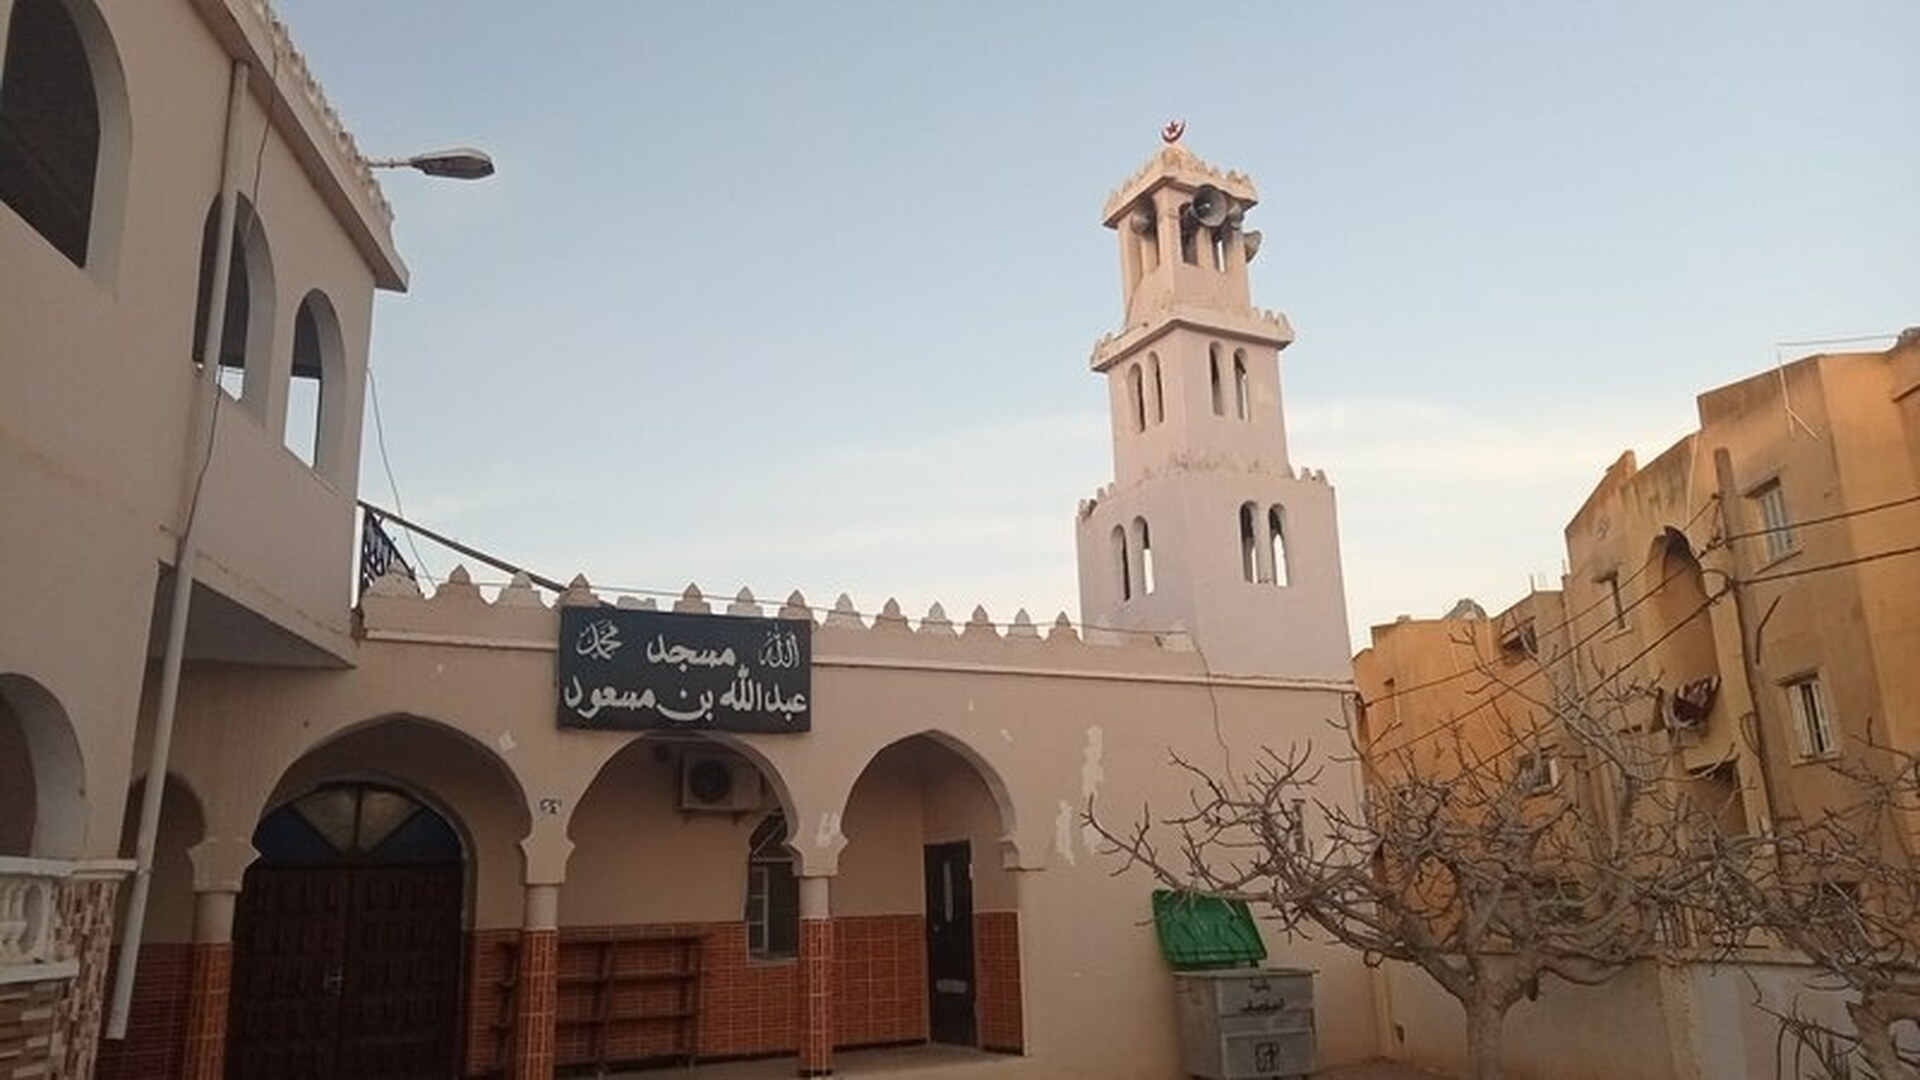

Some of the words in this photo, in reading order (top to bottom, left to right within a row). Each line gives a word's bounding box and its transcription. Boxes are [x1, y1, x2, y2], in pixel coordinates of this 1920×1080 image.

[646, 633, 737, 673] مسجد
[758, 623, 799, 669] الله
[563, 675, 657, 720] مسعود
[656, 689, 714, 722] بن
